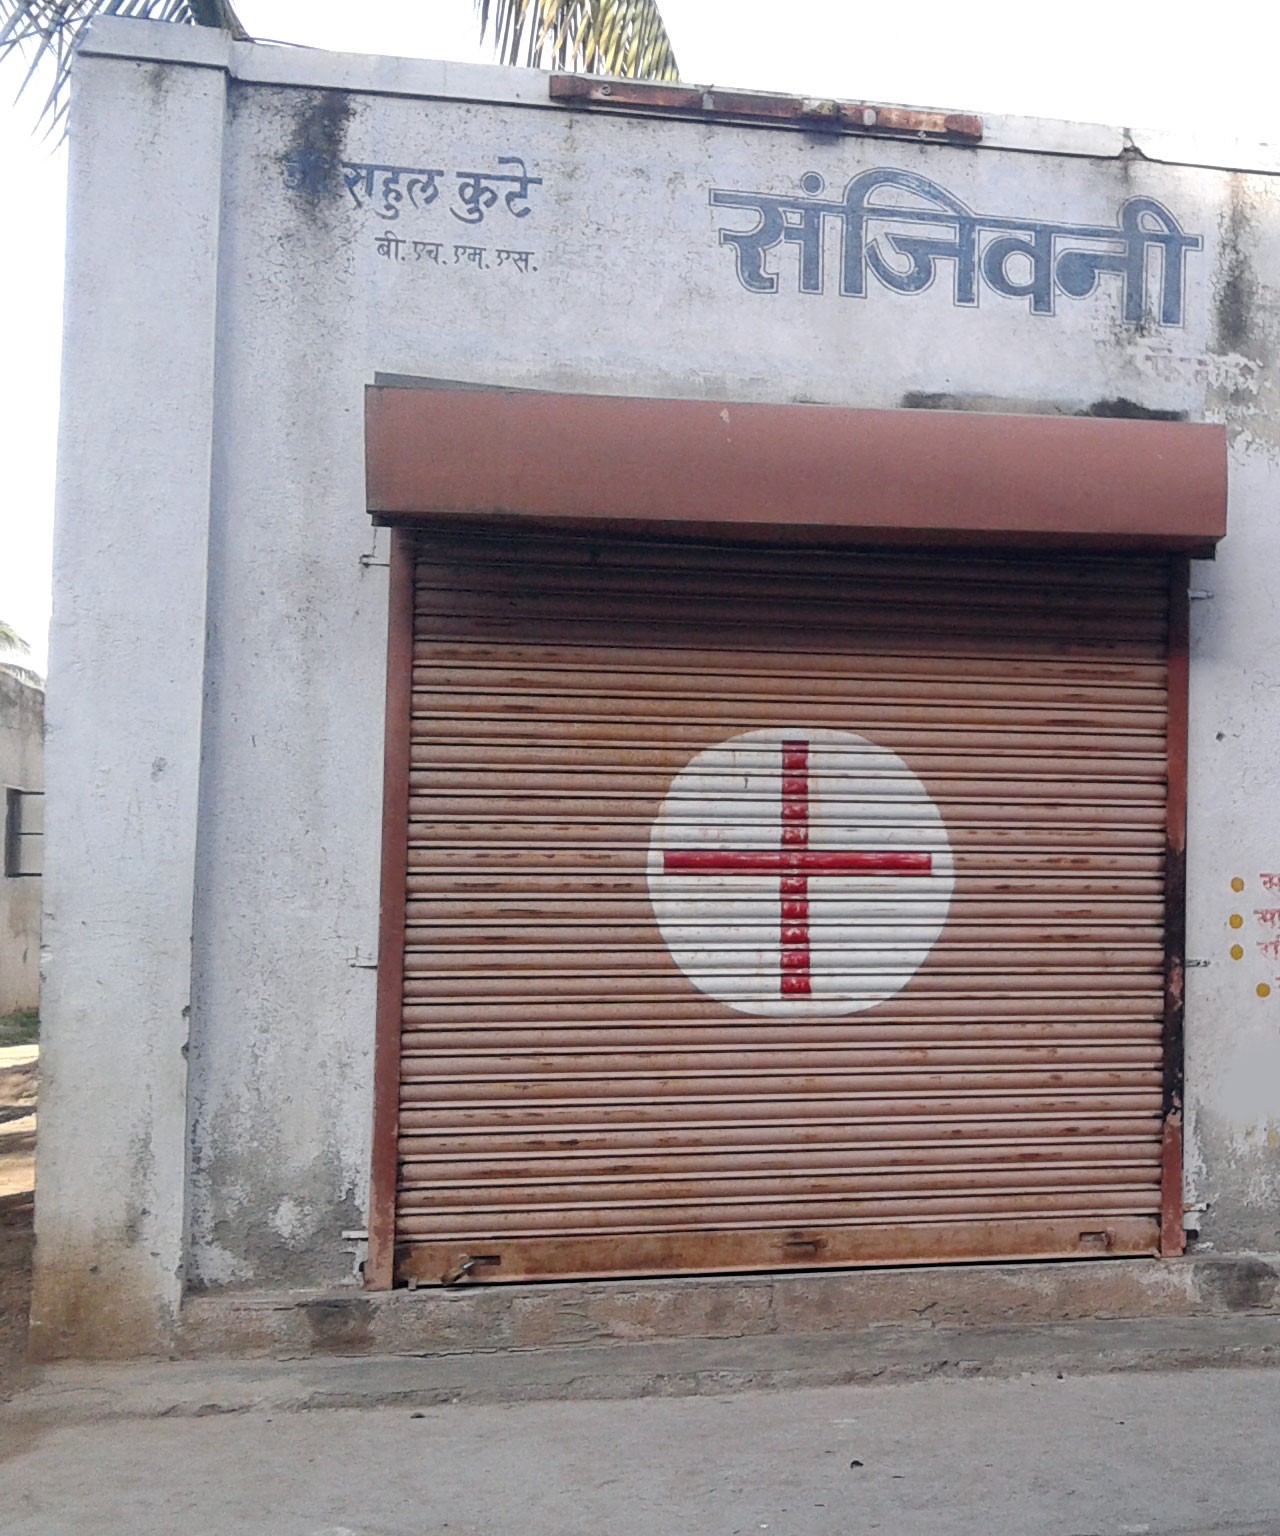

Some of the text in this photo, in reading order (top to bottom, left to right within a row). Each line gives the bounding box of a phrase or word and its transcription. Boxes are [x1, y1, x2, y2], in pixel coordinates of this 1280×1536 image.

[341, 161, 444, 221] राहुल
[449, 156, 543, 224] कुटे
[709, 167, 1204, 329] संजिवनी
